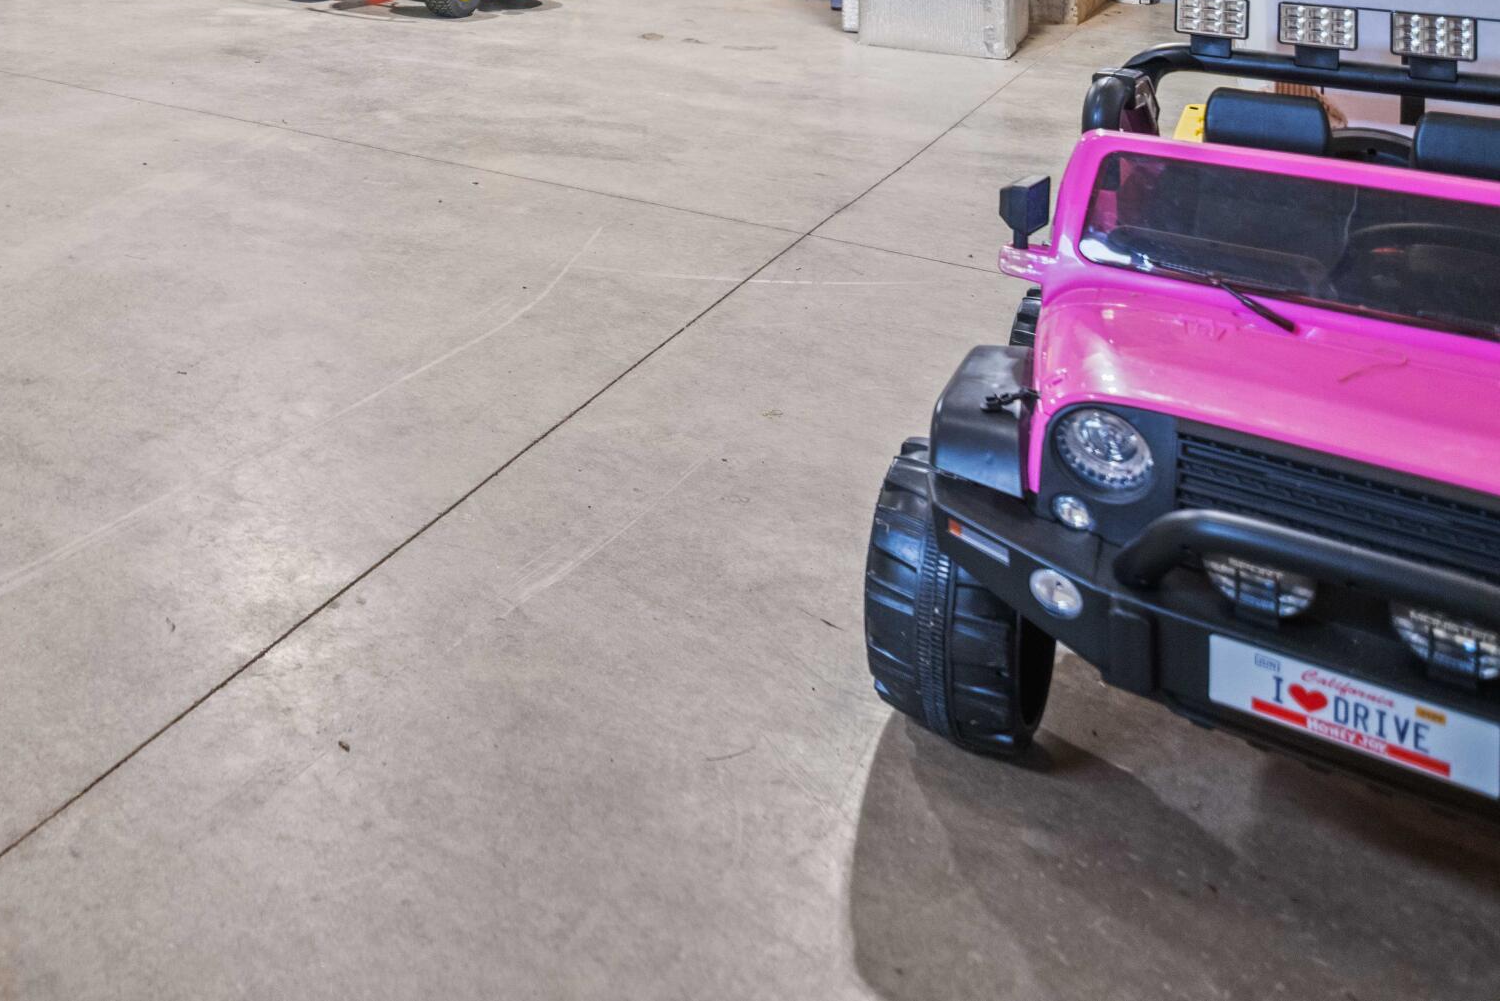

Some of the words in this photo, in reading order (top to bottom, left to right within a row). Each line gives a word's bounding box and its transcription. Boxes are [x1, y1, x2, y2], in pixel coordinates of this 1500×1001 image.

[1273, 676, 1283, 704] I
[1334, 696, 1430, 753] DRIVE
[1301, 669, 1395, 707] California
